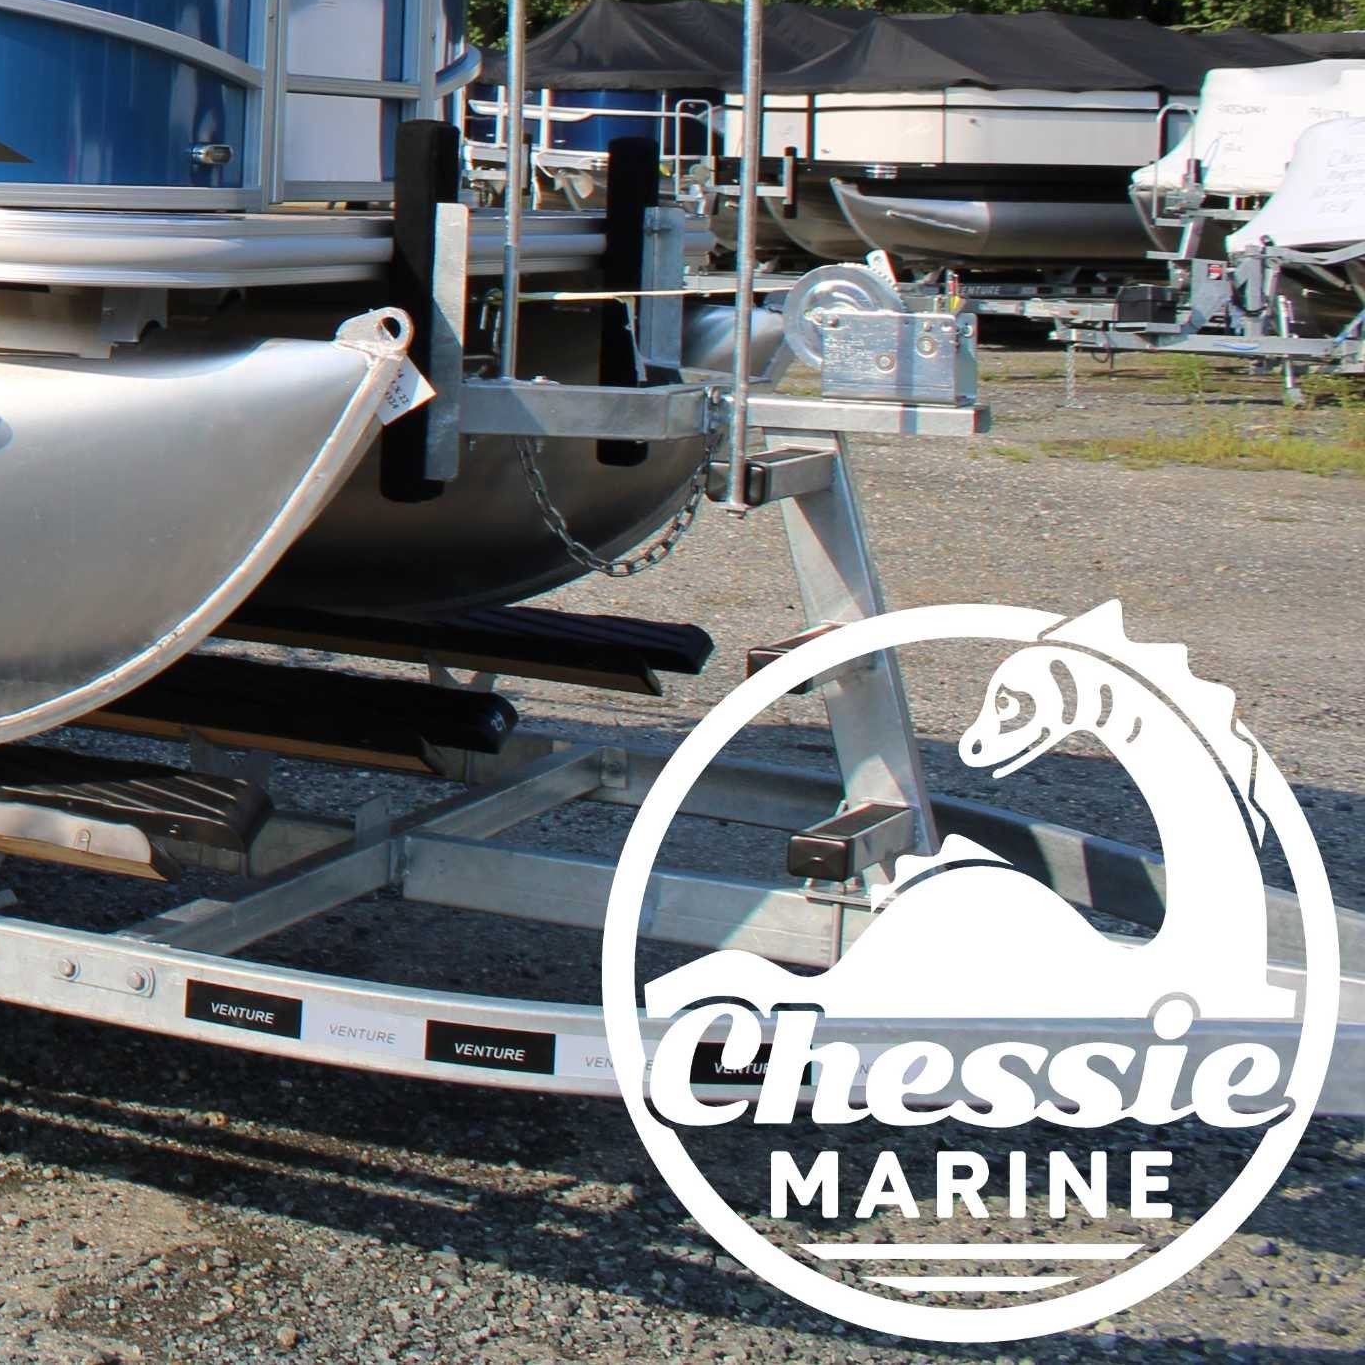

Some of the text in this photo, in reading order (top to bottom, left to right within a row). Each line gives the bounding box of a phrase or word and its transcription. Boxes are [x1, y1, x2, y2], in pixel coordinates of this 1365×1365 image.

[210, 1002, 275, 1026] VENTURE
[328, 1023, 397, 1045] VENTURE
[454, 1042, 526, 1062] VENTURE
